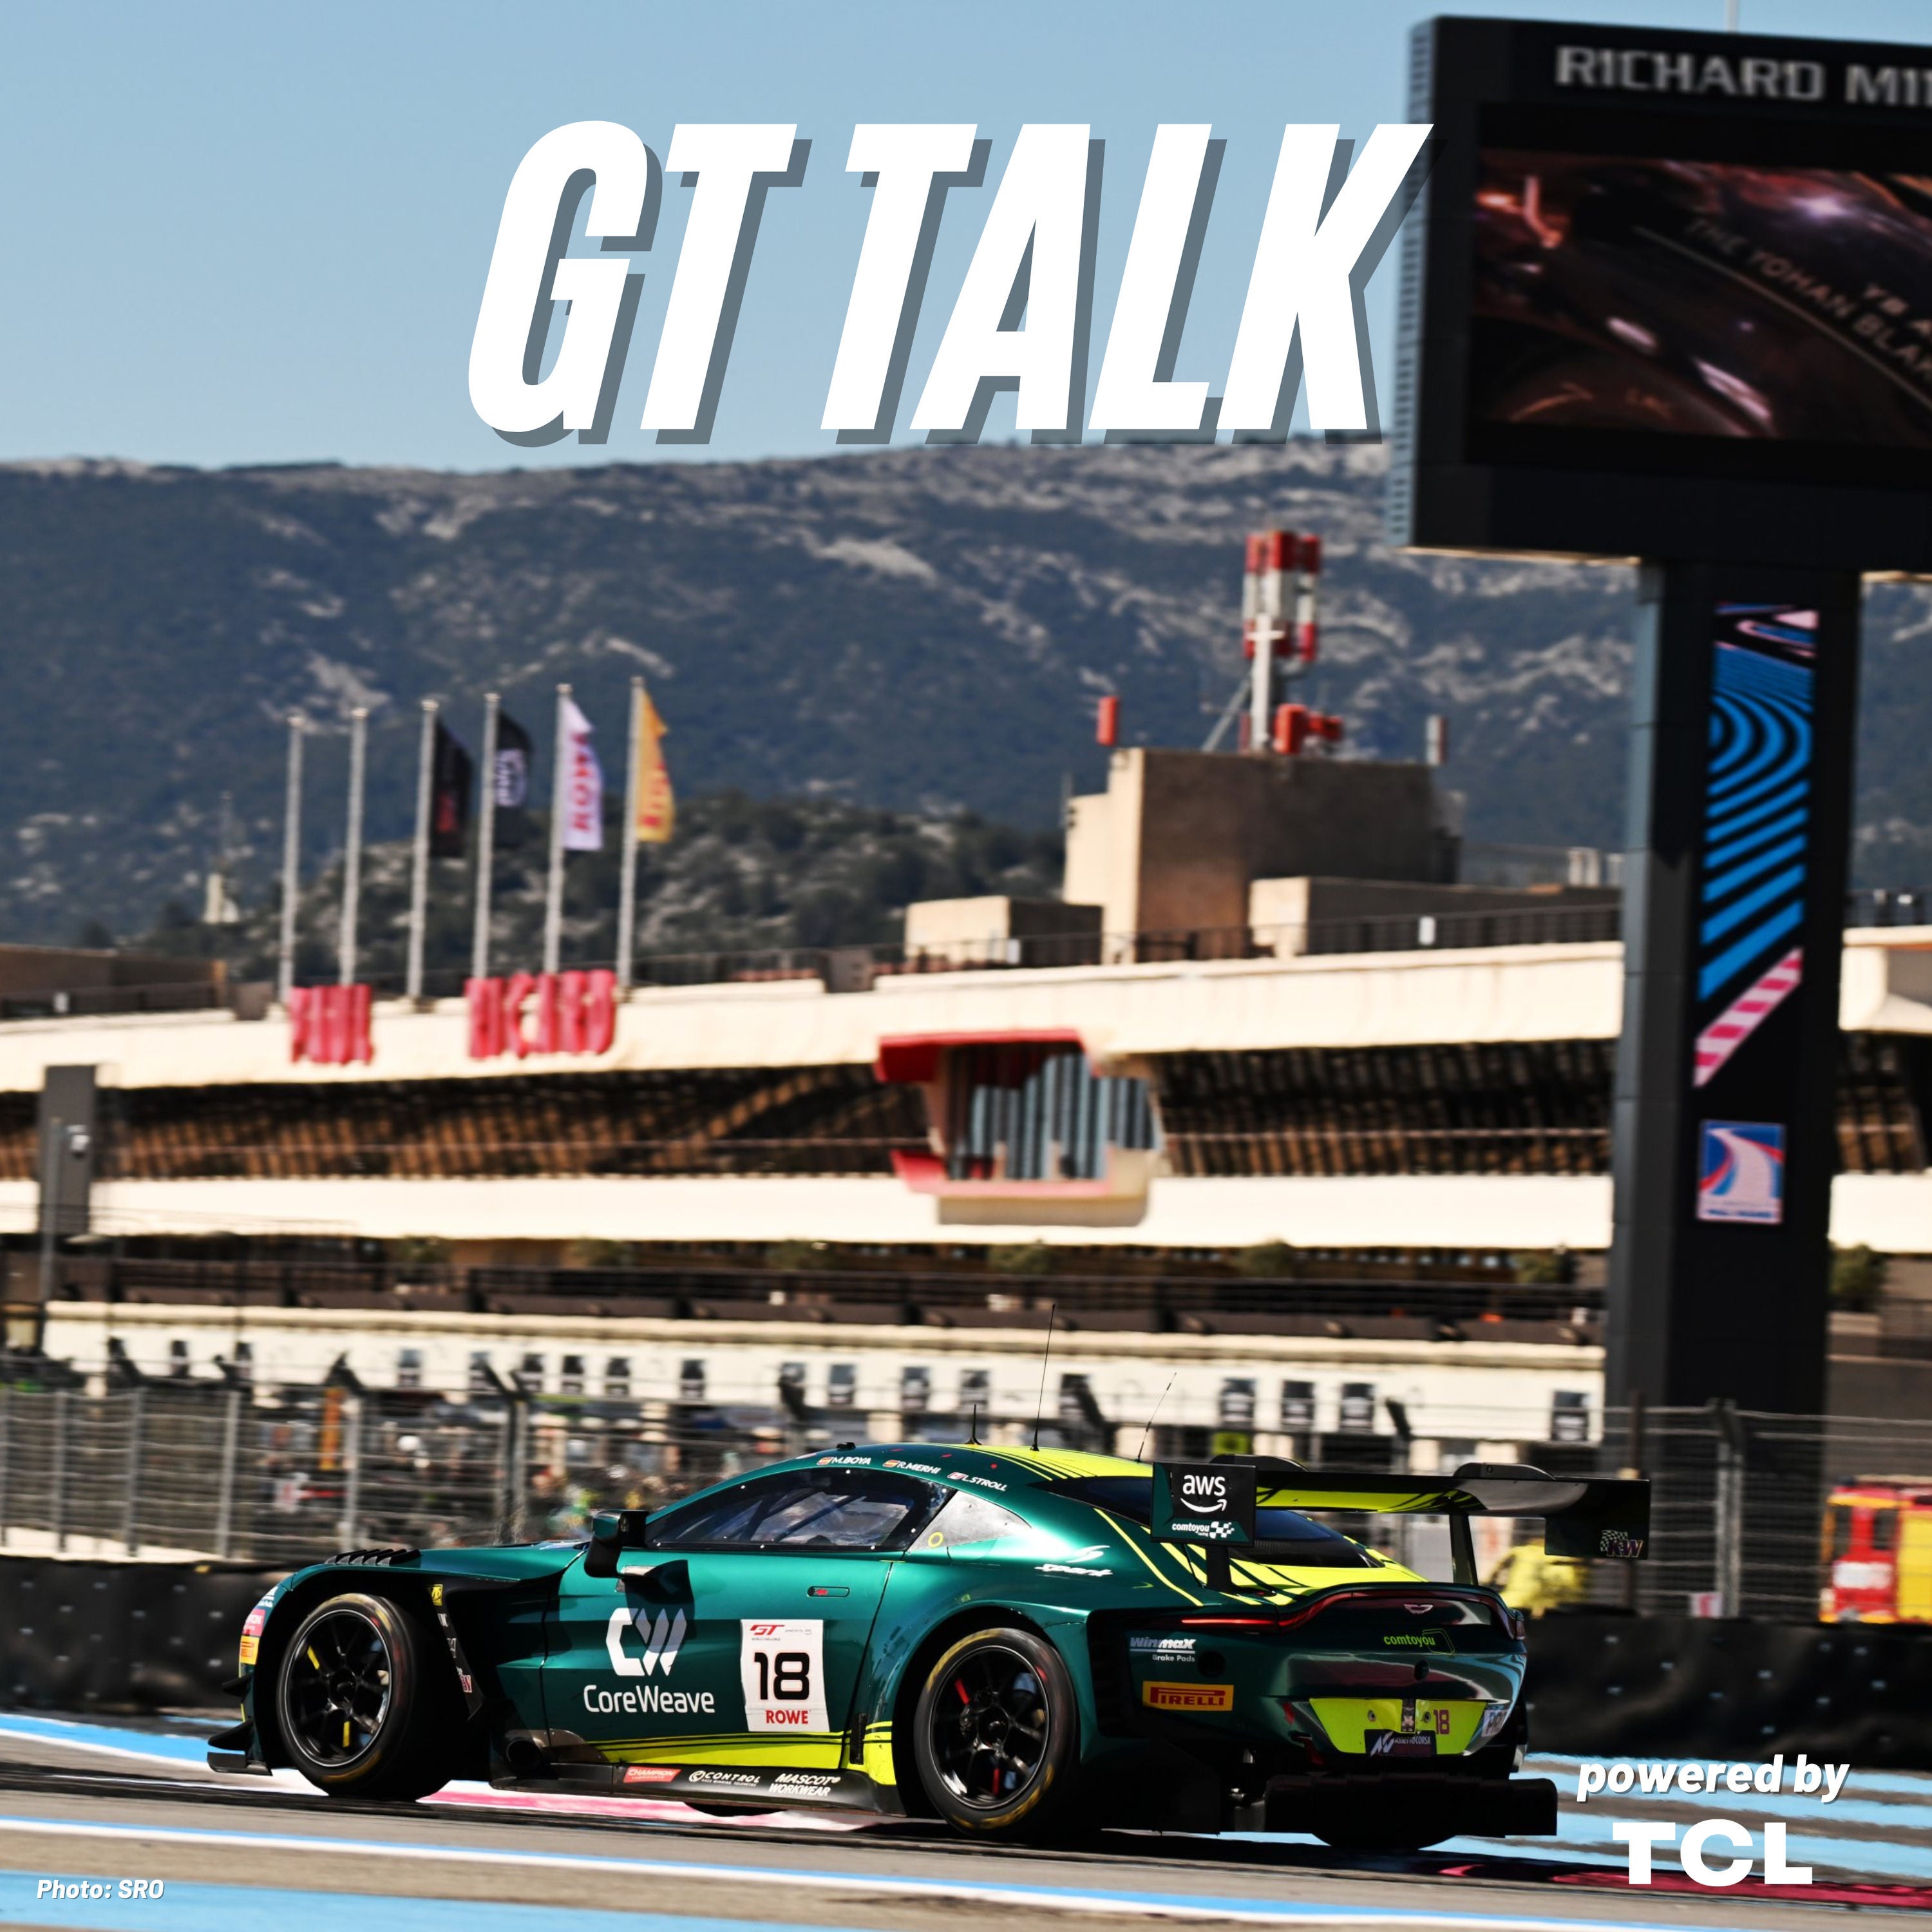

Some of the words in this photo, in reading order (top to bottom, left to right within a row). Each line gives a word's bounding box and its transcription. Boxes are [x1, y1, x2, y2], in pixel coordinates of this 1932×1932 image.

[1555, 46, 1825, 101] RICHARD
[1844, 64, 1932, 108] MI
[896, 1461, 942, 1475] R.MERHI
[963, 1474, 1008, 1492] L.STROLL
[1182, 1474, 1226, 1497] aws
[1171, 1522, 1210, 1533] comtoyou
[1383, 1634, 1436, 1647] comtoyou
[754, 1652, 810, 1700] 18
[583, 1685, 715, 1713] CoreWeave
[1150, 1687, 1226, 1706] PIRELLI
[766, 1710, 809, 1724] ROWE
[1433, 1709, 1450, 1735] 18
[705, 1772, 761, 1783] CONTROL
[769, 1783, 831, 1797] WORKWEAR
